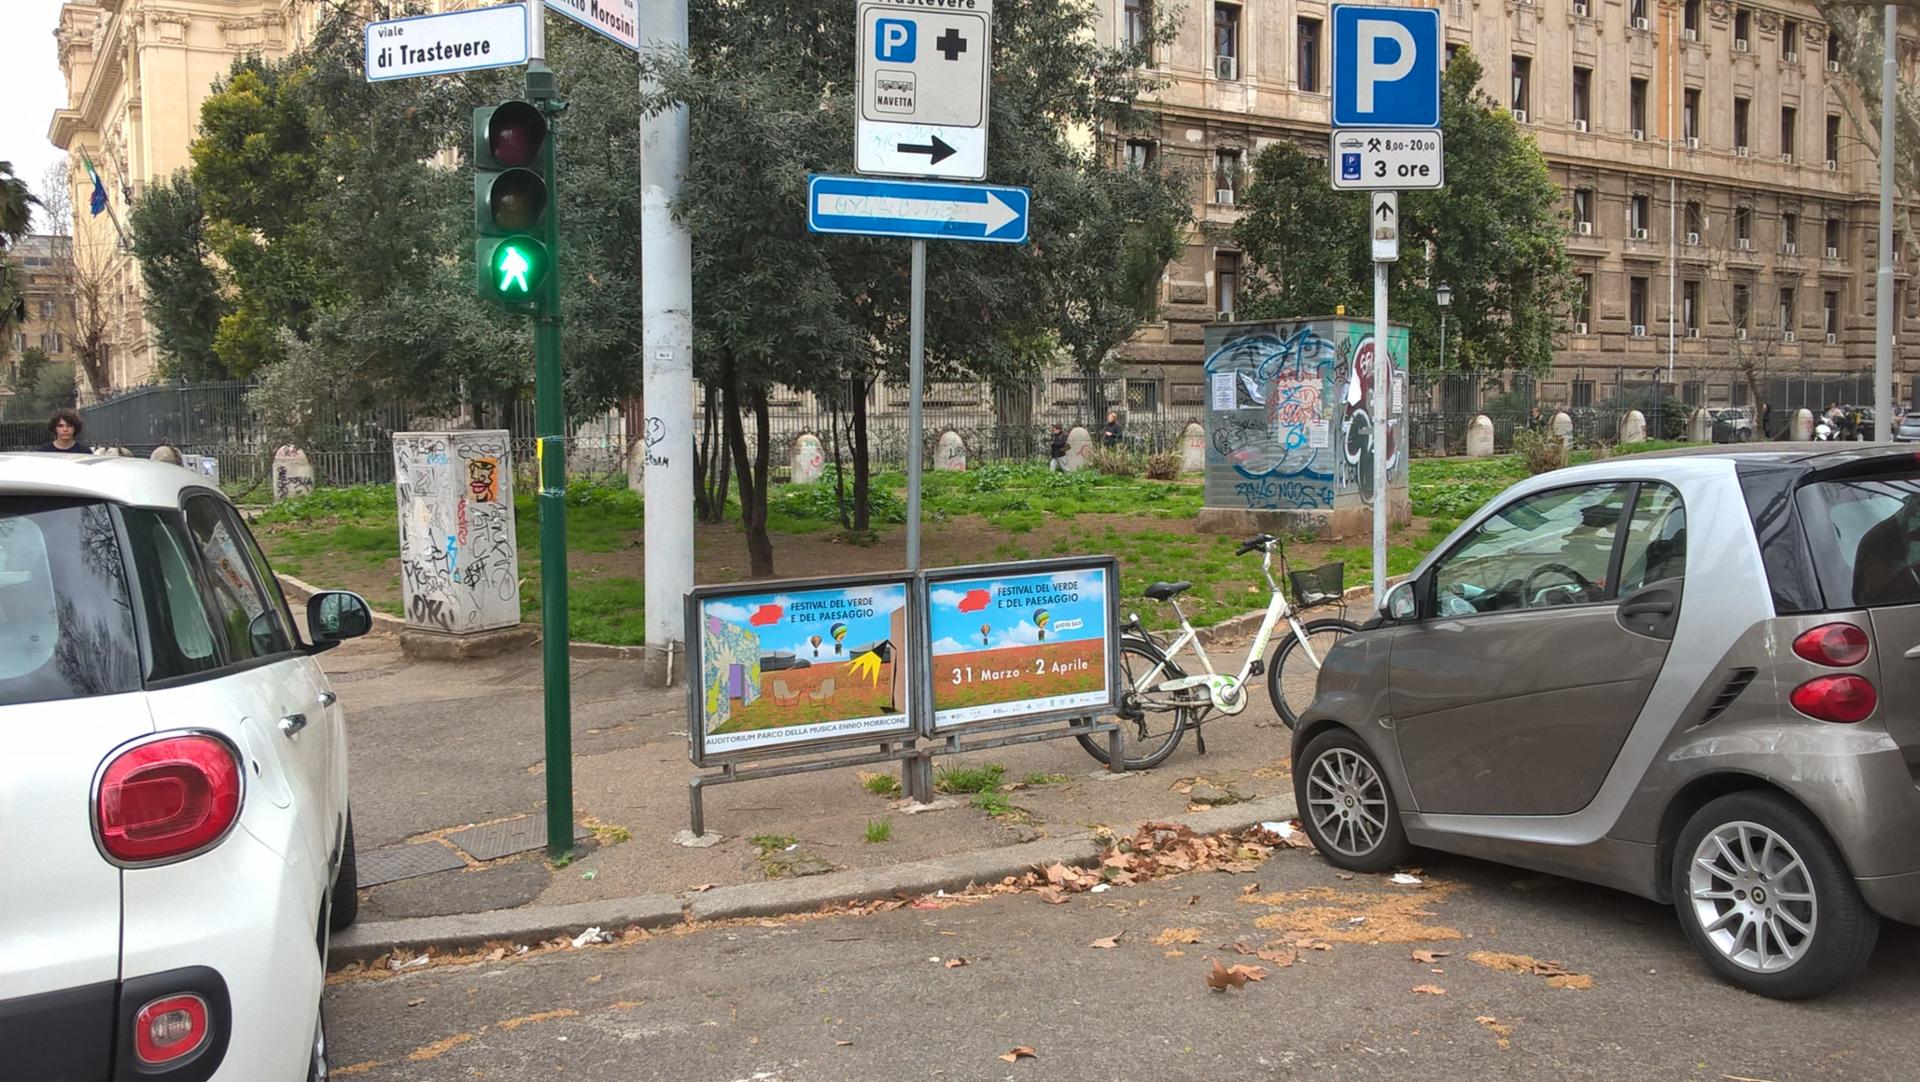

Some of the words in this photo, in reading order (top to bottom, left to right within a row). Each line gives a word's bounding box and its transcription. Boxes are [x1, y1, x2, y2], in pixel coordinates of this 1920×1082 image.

[591, 0, 634, 38] Morosini
[378, 26, 404, 38] viale
[883, 23, 908, 57] P
[378, 47, 392, 68] di
[400, 40, 491, 65] Trastevere
[1356, 19, 1417, 113] P
[877, 95, 913, 108] NAVETTA
[1374, 160, 1387, 178] 3
[1397, 164, 1430, 177] ore
[997, 585, 1033, 597] FESTIVAL
[1035, 584, 1050, 593] DEL
[1052, 581, 1079, 592] VERDE
[790, 601, 827, 611] FESTIVAL
[830, 599, 845, 609] DEL
[847, 597, 873, 607] VERDE
[998, 599, 1003, 609] E
[1006, 598, 1022, 608] DEL
[1025, 593, 1079, 606] PAESAGGIO
[791, 614, 796, 623] E
[799, 613, 816, 622] DEL
[819, 608, 874, 621] PAESAGGIO
[952, 667, 972, 685] 31
[981, 669, 1020, 681] Marzo
[1035, 658, 1045, 675] 2
[1051, 658, 1088, 675] Aprile
[706, 734, 756, 745] AUDITORIUM
[757, 731, 783, 740] PARCO
[784, 727, 809, 737] DELLA
[809, 725, 837, 734] MUSICA
[838, 722, 862, 730] ENNIO
[863, 717, 905, 728] MORRICONE
